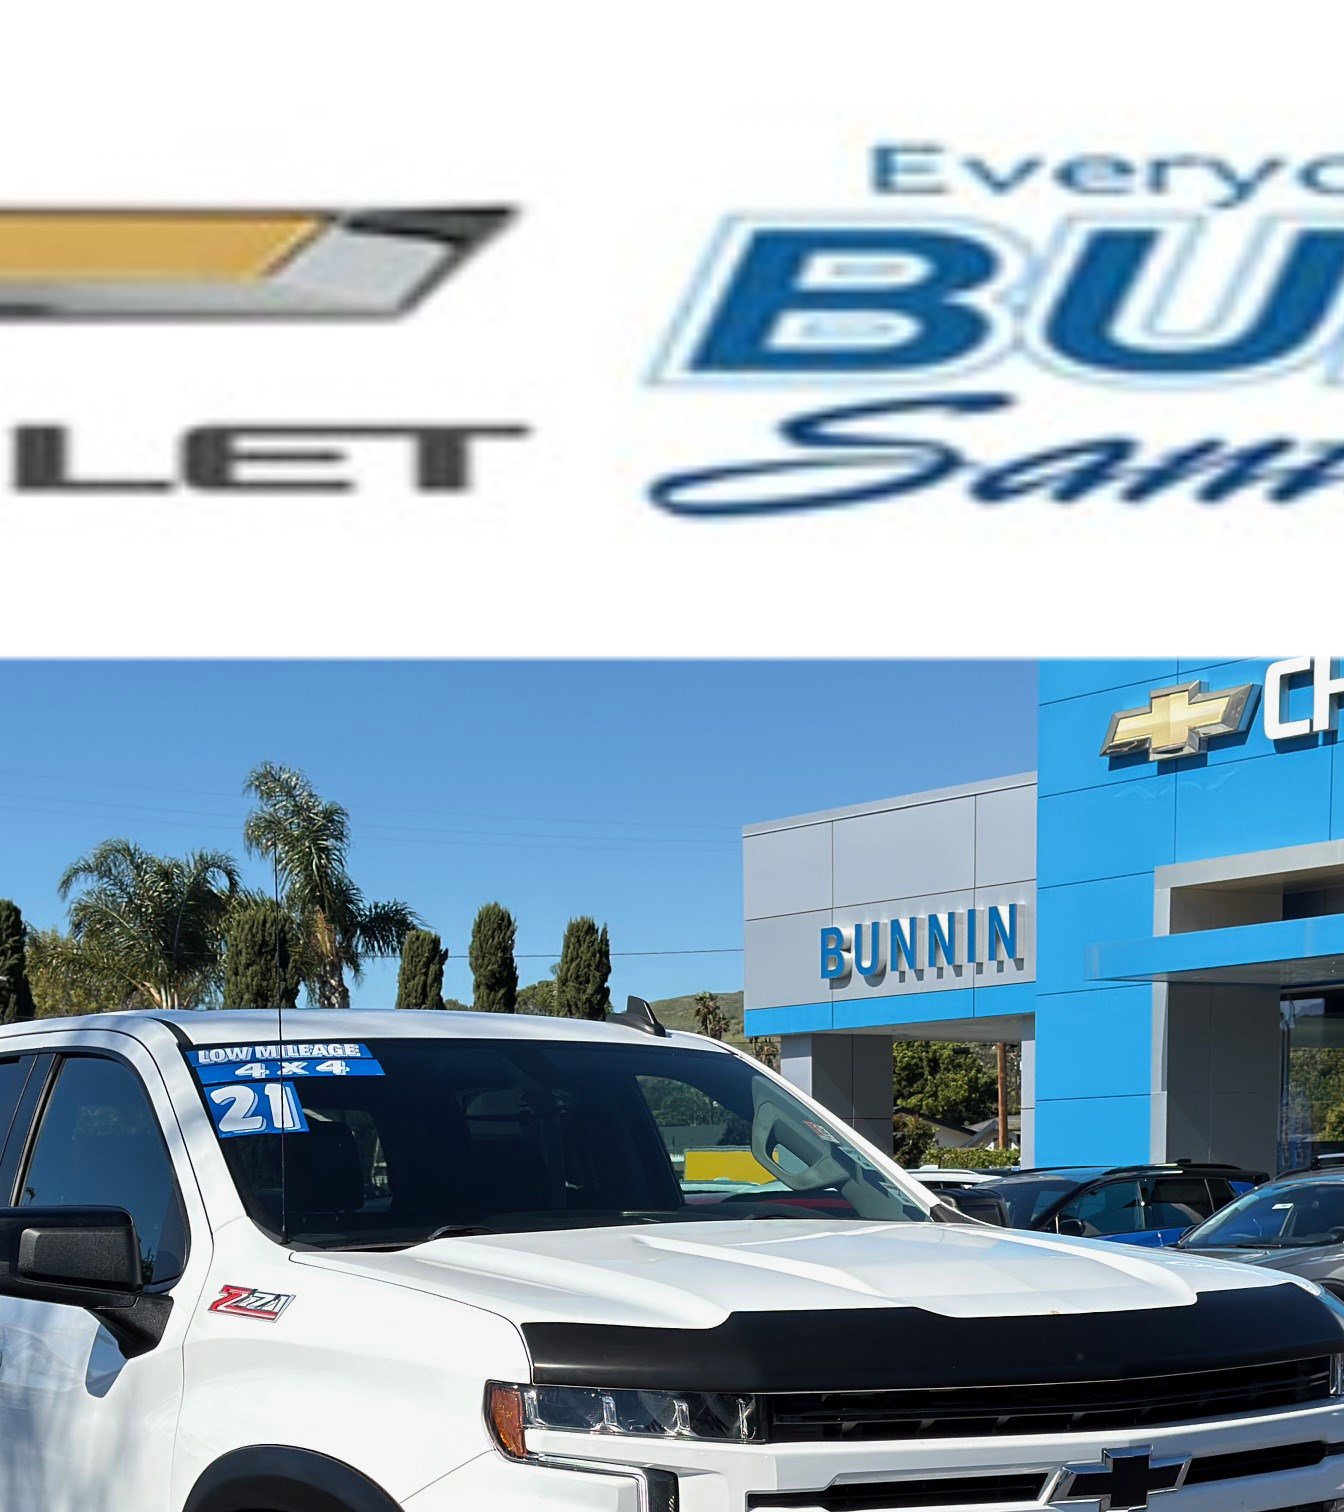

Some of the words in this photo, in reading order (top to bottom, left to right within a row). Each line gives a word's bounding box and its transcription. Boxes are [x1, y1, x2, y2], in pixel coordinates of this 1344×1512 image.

[820, 903, 1022, 980] BUNNIN
[198, 1046, 253, 1064] LOW
[255, 1043, 361, 1059] MILEAGE
[210, 1083, 302, 1133] 21
[207, 1284, 297, 1323] Z71
